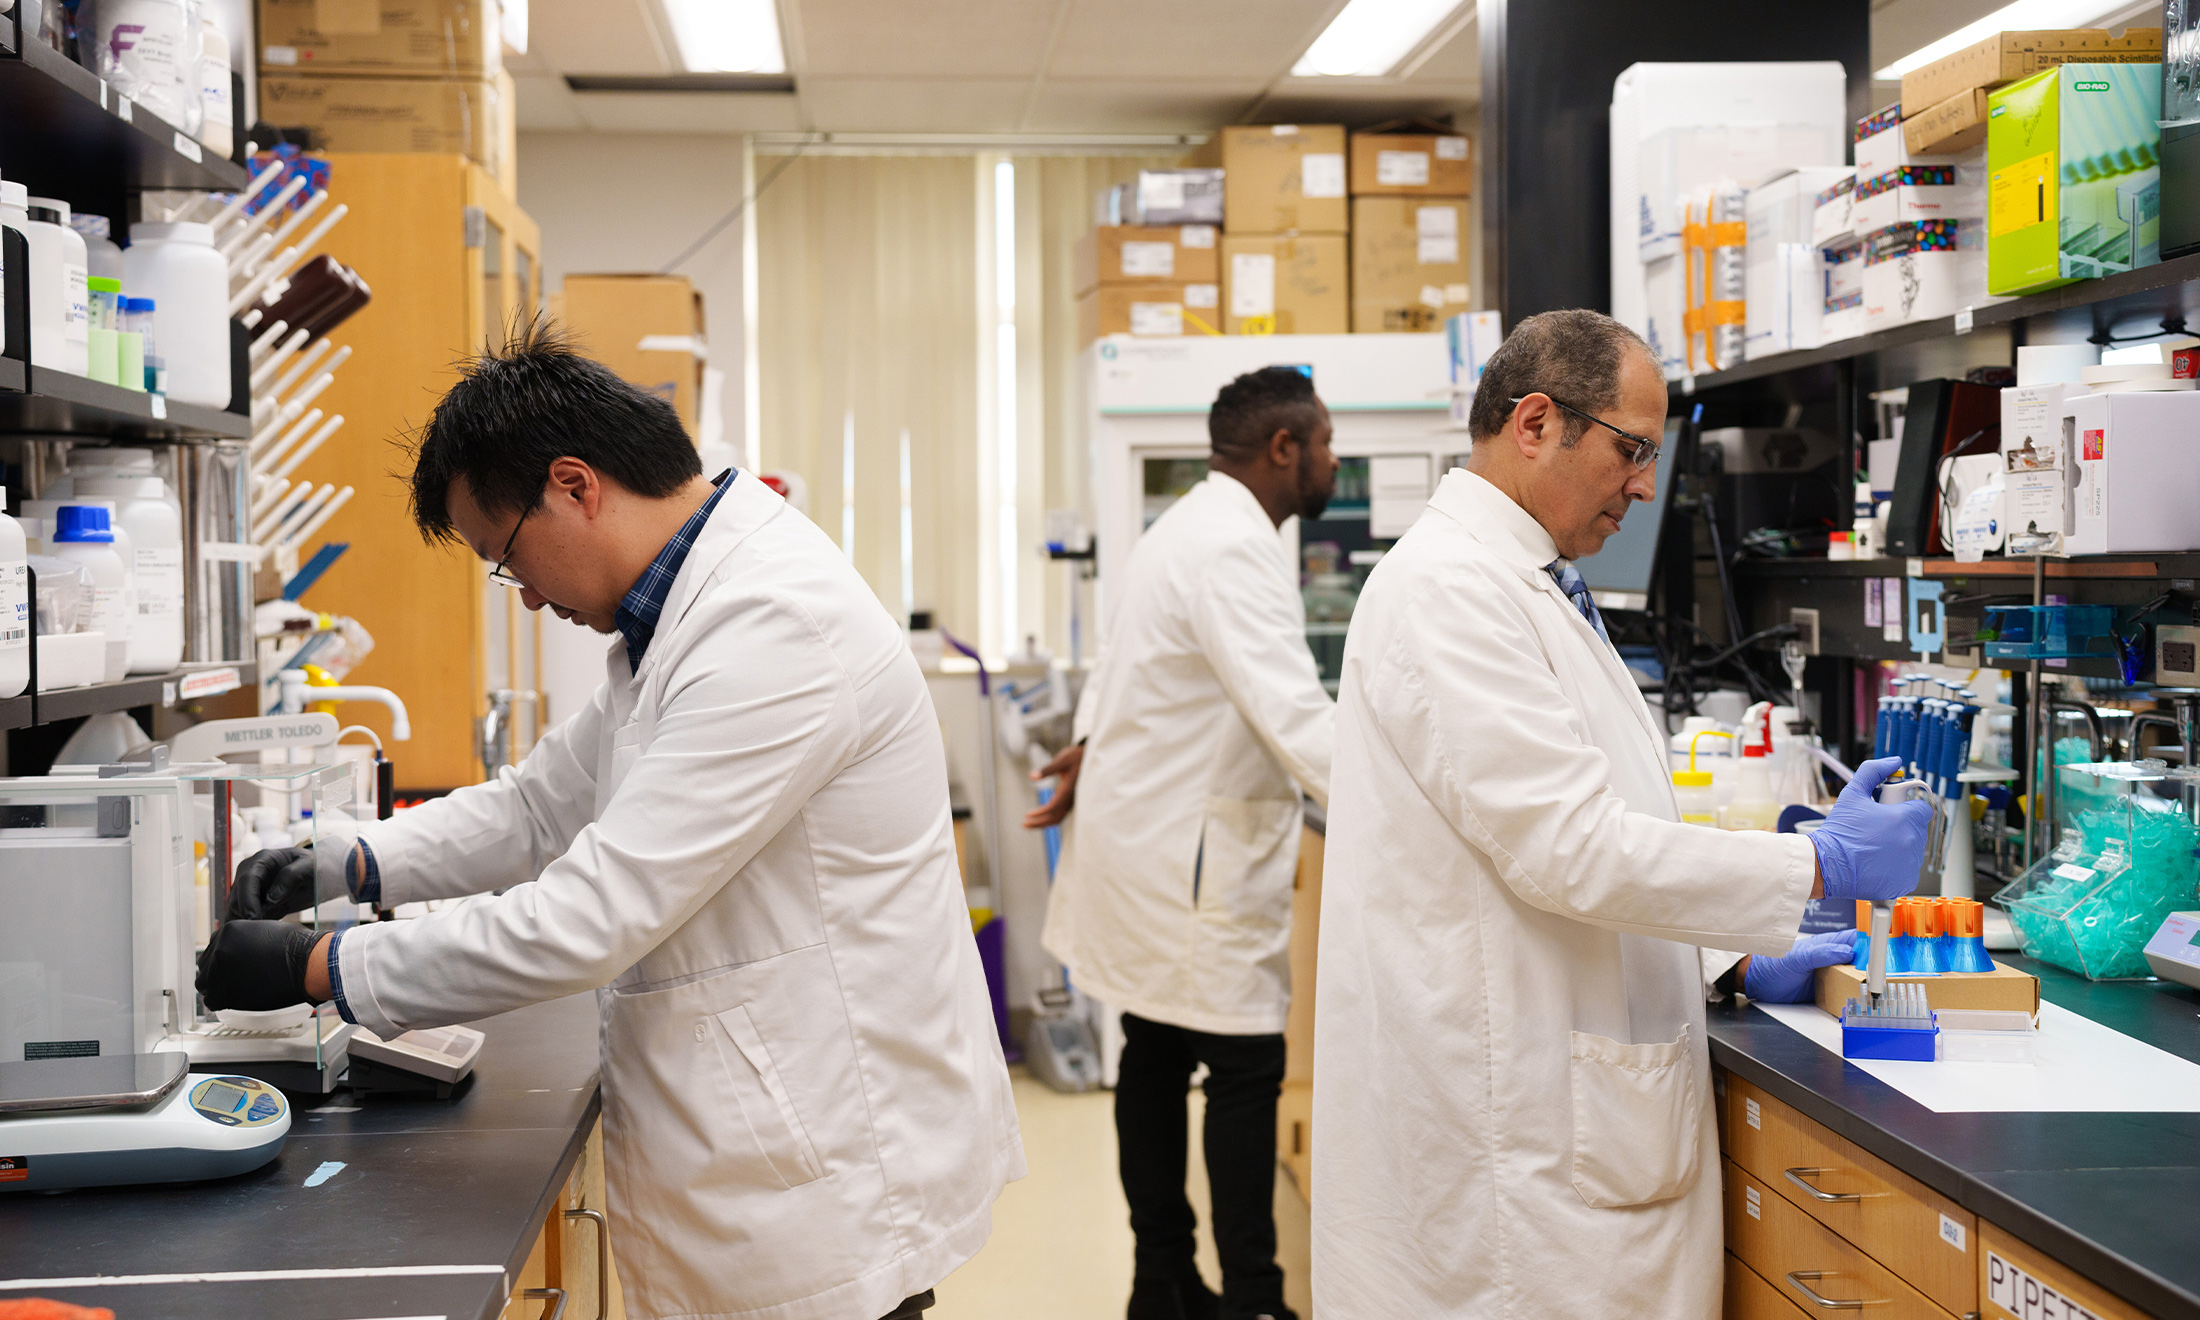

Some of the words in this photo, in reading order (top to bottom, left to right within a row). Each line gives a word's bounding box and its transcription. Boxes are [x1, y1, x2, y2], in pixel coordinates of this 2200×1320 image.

[2037, 55, 2049, 64] 20
[2051, 55, 2064, 63] mL
[2067, 55, 2117, 63] Disposable
[2076, 82, 2109, 91] BIO-RAD
[2175, 356, 2190, 372] 40
[225, 728, 273, 742] METTLER
[278, 725, 323, 738] TOLEDO
[1991, 1255, 2097, 1320] PIPET
